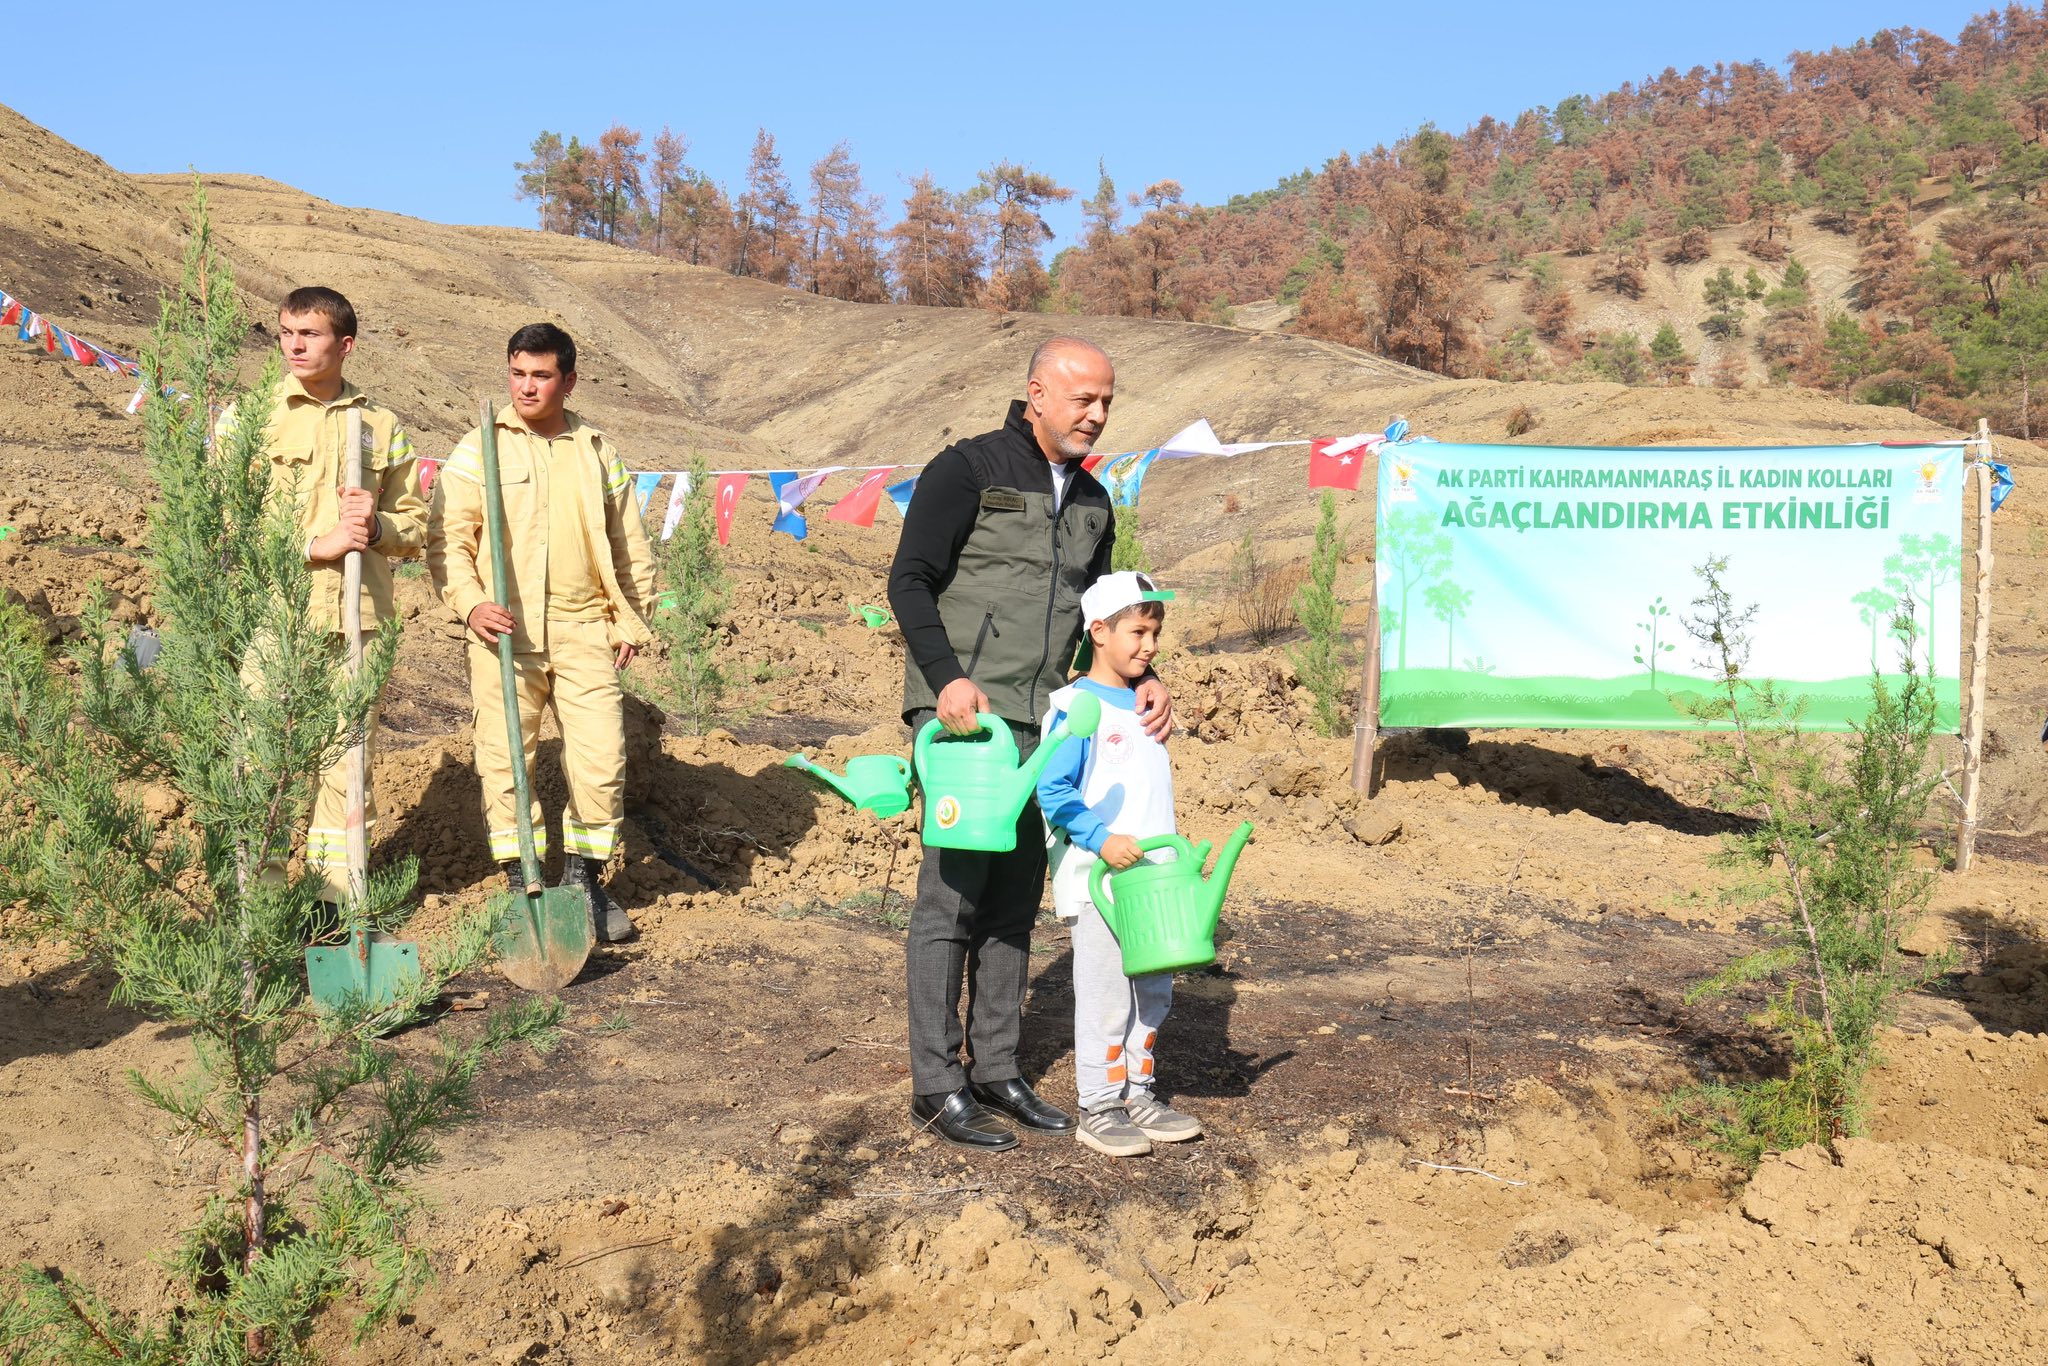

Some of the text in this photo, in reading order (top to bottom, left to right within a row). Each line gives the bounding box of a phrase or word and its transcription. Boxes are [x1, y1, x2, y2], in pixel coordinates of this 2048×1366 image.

[1436, 465, 1892, 491] AK PARTİ KAHRAMANMARAŞ İL KADIN KOLLARI
[1440, 495, 1890, 534] AĞAÇLANDIRMA ETKİNLİĞİ
